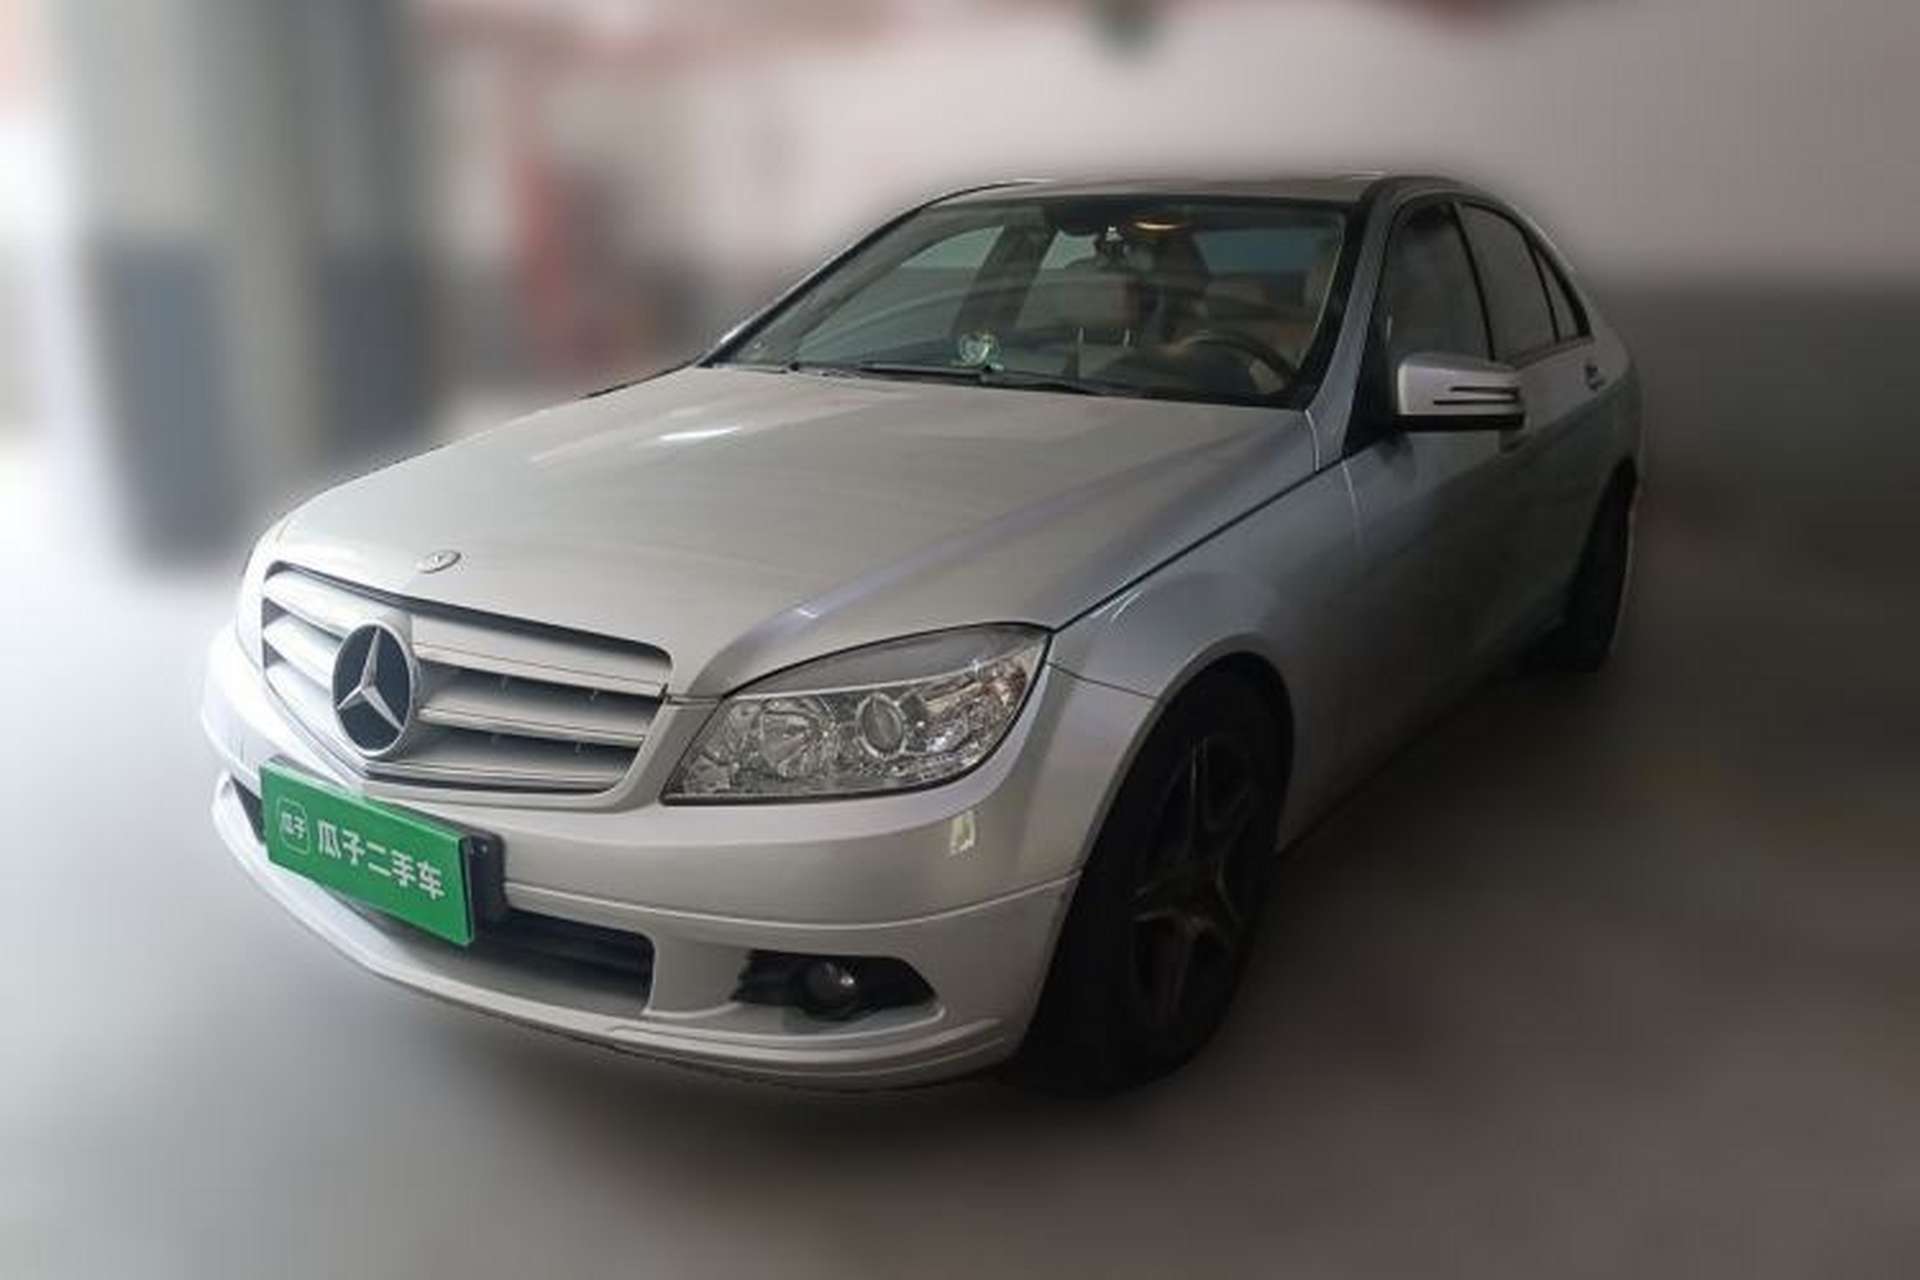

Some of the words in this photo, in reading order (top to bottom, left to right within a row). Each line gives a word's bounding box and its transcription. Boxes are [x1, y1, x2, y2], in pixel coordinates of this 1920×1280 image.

[317, 819, 445, 900] 瓜子二手车
